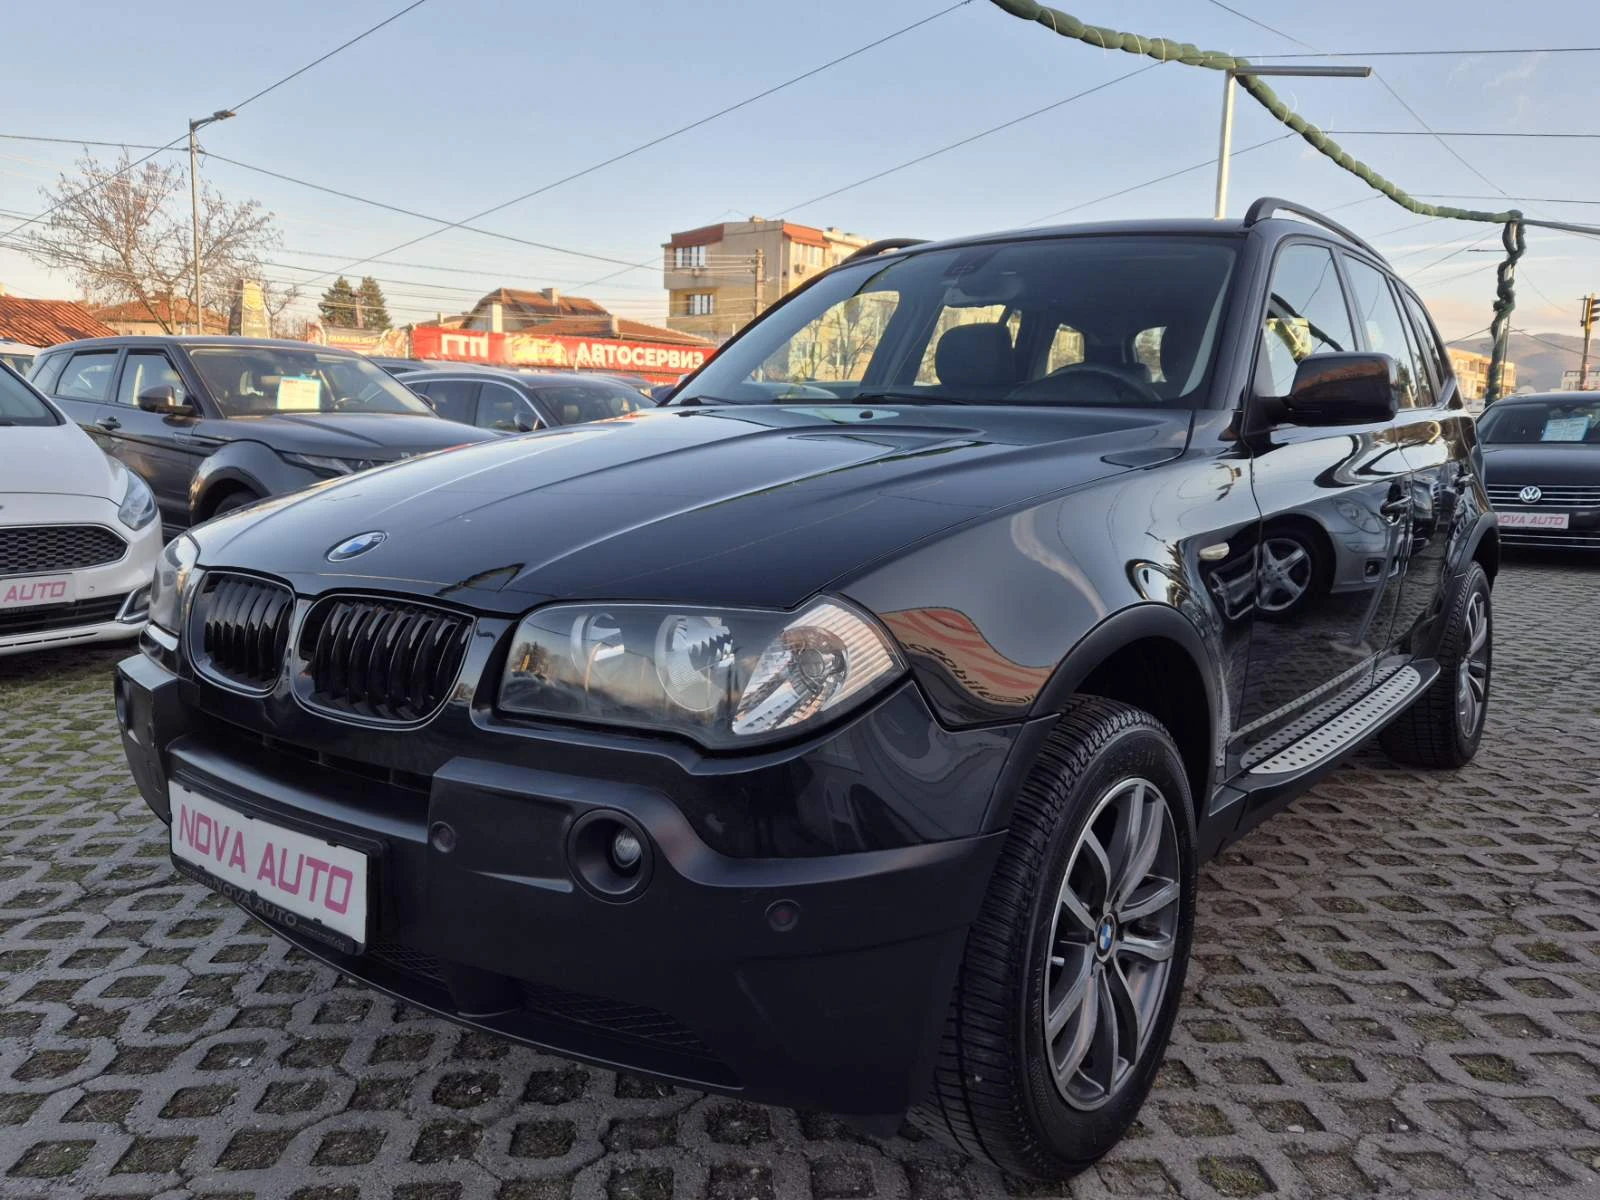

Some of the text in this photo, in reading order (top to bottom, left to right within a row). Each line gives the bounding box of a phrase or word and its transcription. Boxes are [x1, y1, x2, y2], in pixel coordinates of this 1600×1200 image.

[441, 333, 489, 358] ГТП
[576, 341, 705, 370] АВТОСЕРВИЗ
[1529, 516, 1564, 526] AUTO
[4, 581, 67, 602] AUTO
[179, 803, 354, 916] NOVA AUTO
[211, 878, 254, 909] NOVA
[252, 899, 298, 926] AUTO
